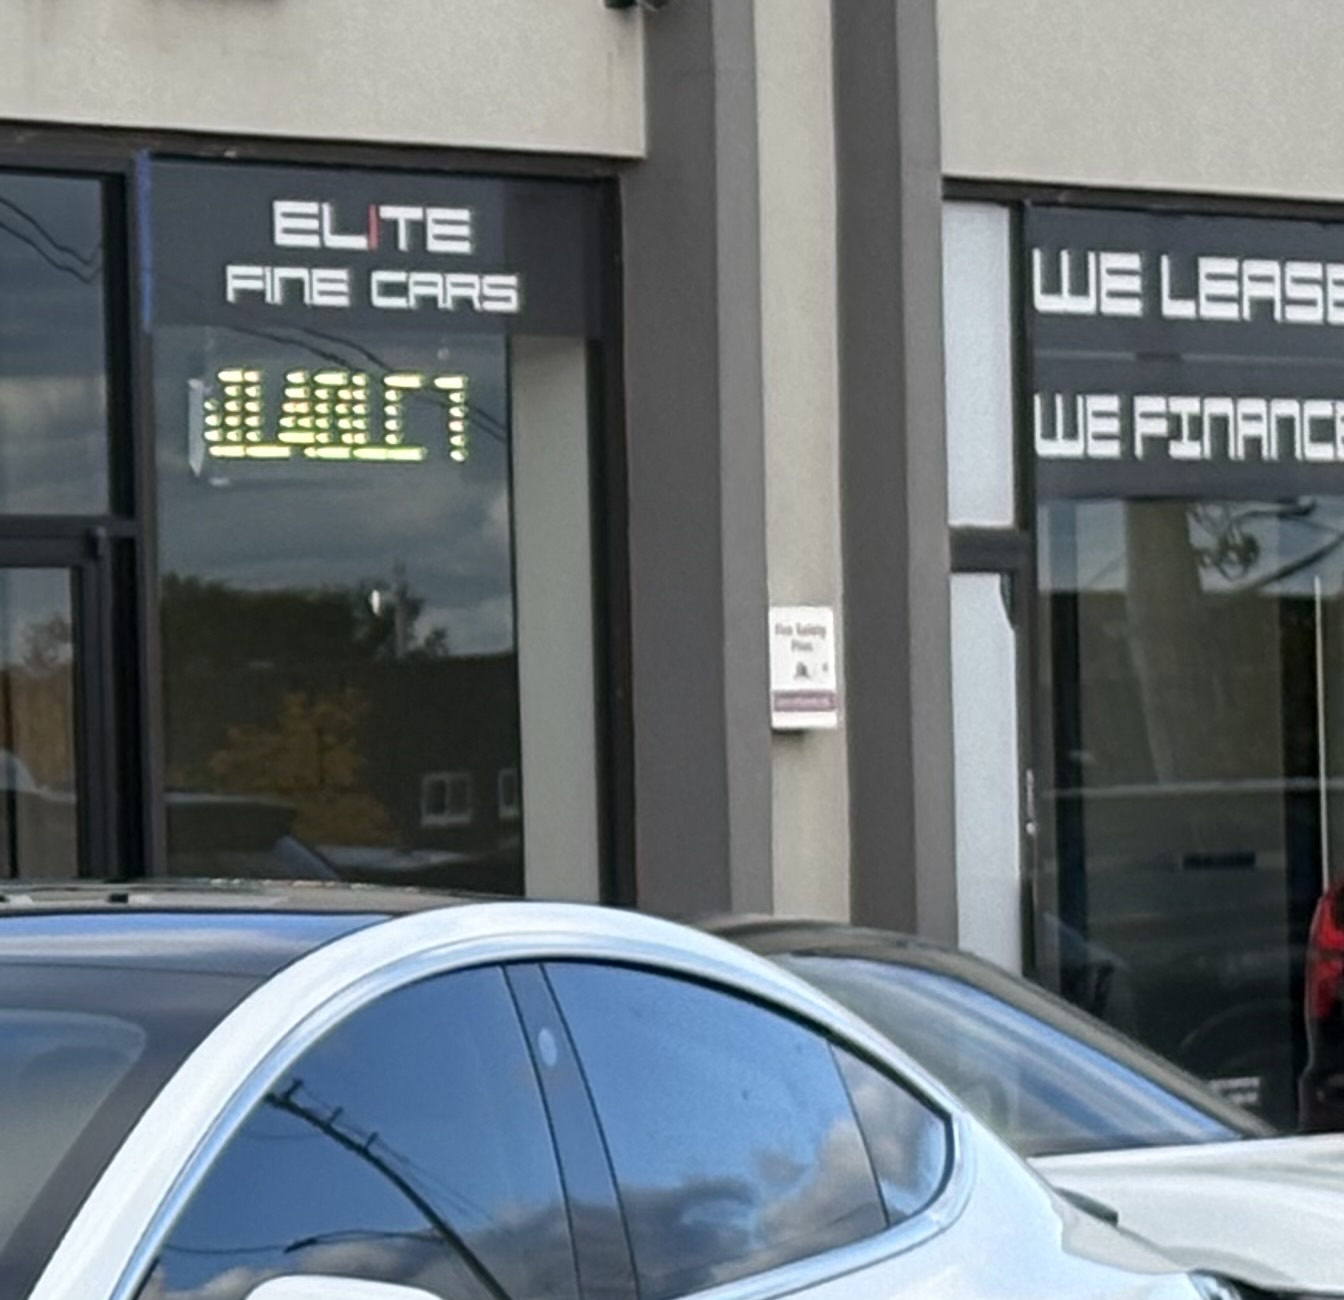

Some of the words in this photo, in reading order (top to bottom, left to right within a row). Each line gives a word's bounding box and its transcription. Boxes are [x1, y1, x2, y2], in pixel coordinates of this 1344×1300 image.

[273, 200, 474, 254] ELITE
[225, 265, 350, 307] FINE
[370, 270, 521, 312] CARS
[1033, 249, 1143, 317] WE
[1034, 394, 1121, 458] WE
[1133, 395, 1344, 461] FINANC
